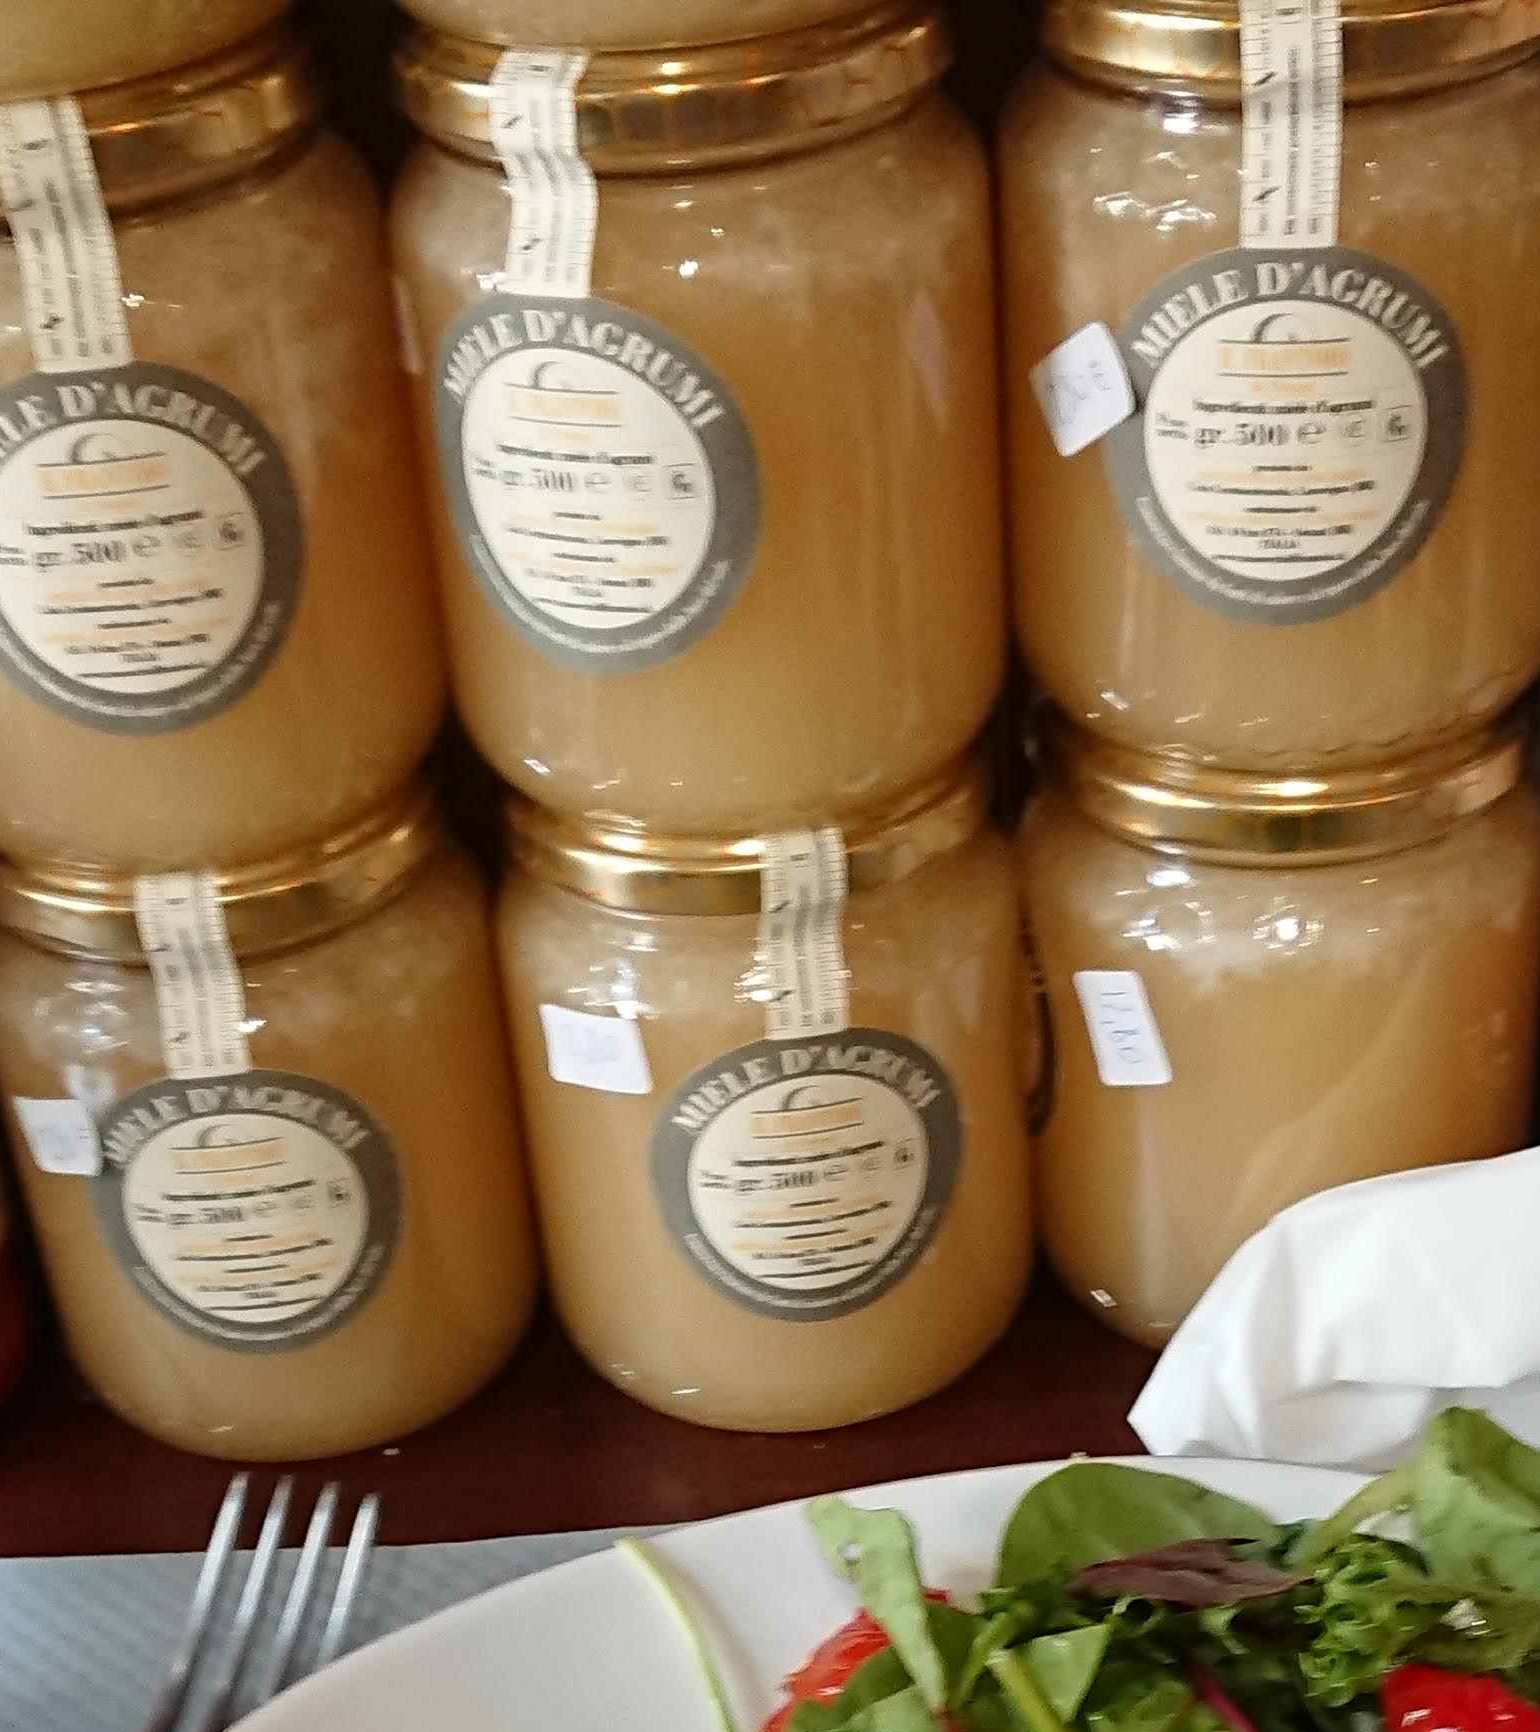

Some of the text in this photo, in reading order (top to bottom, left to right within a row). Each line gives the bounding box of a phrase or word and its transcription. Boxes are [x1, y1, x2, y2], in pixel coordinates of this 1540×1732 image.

[444, 312, 523, 405] MIELE
[1131, 261, 1452, 369] MIELE D'AGRUMI
